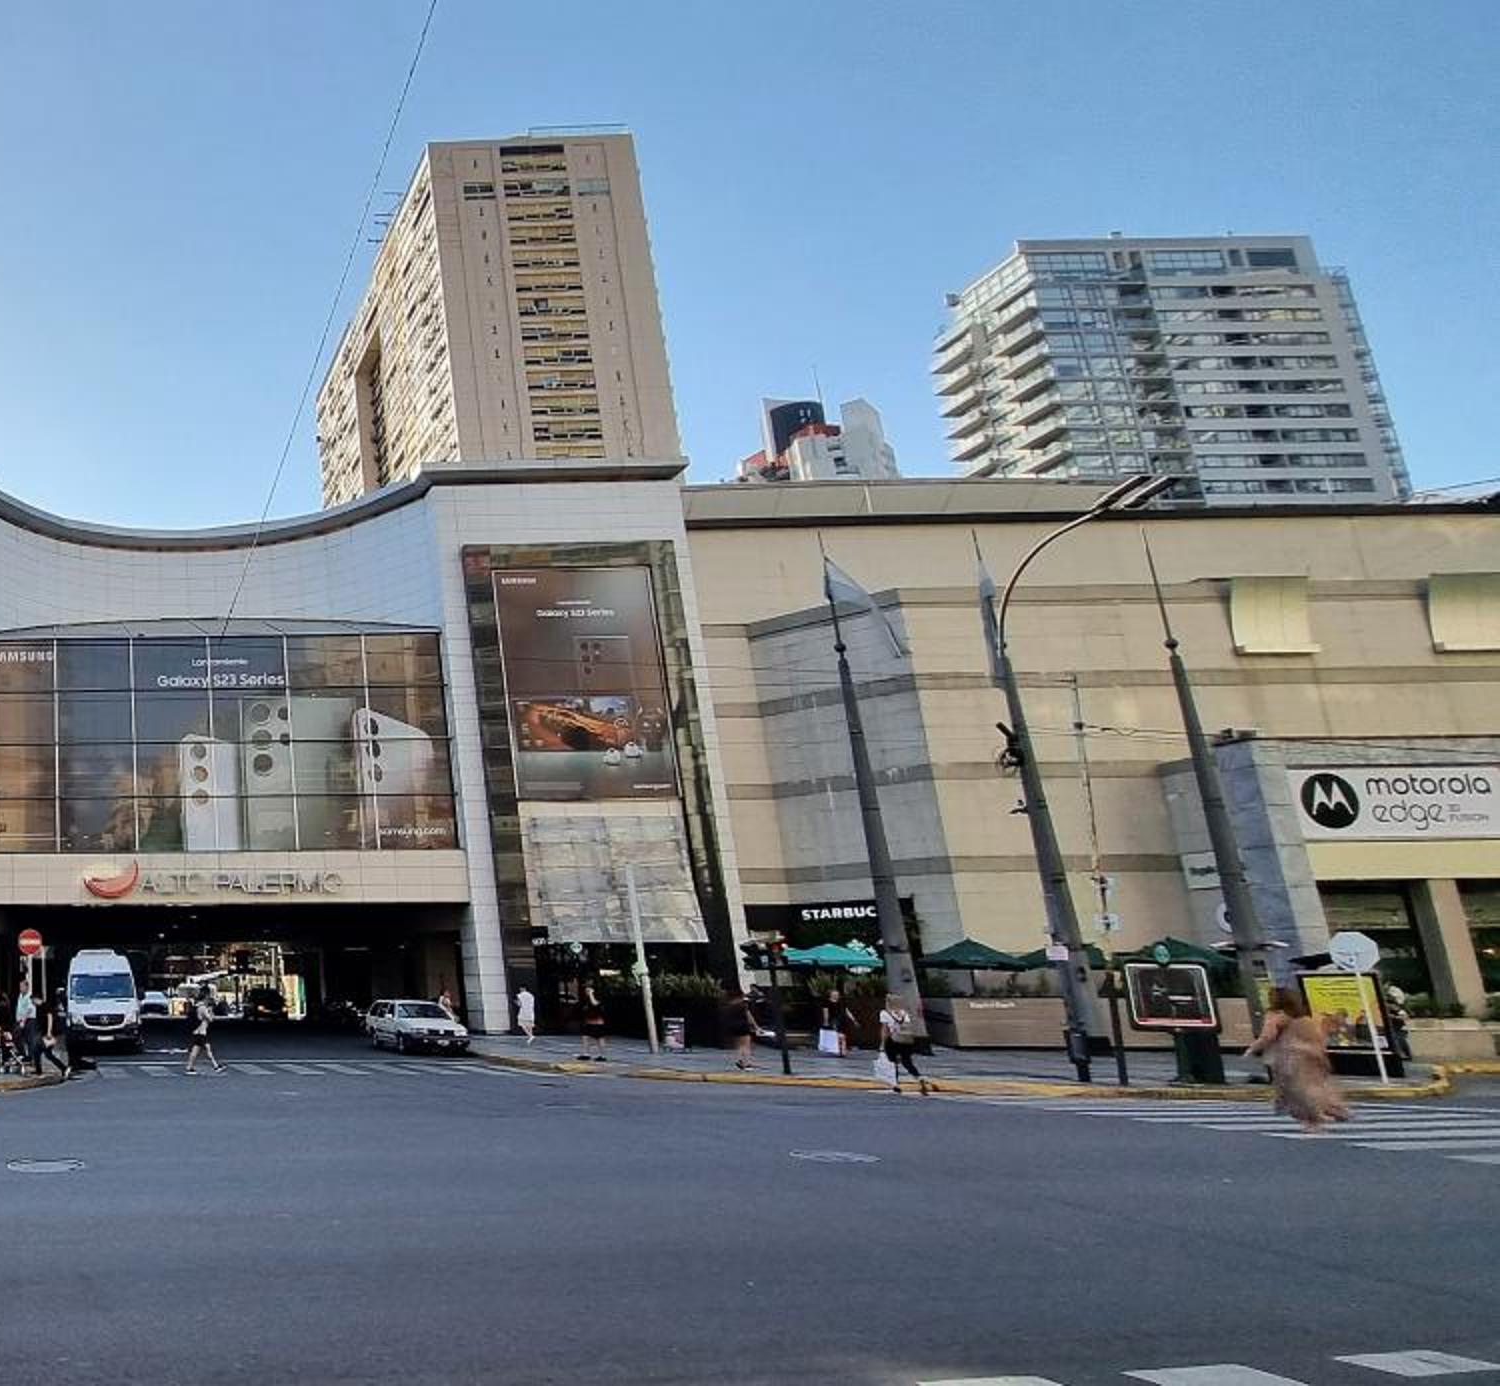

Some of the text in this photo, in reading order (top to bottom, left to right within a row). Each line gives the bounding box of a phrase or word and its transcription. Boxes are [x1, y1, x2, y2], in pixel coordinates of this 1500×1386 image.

[191, 658, 249, 667] Lanamiento
[157, 672, 285, 688] Galaxy S23 Series
[1365, 774, 1492, 795] motorola
[1372, 800, 1446, 831] edge
[212, 870, 344, 896] PALERMO
[801, 905, 878, 920] STARBUC
